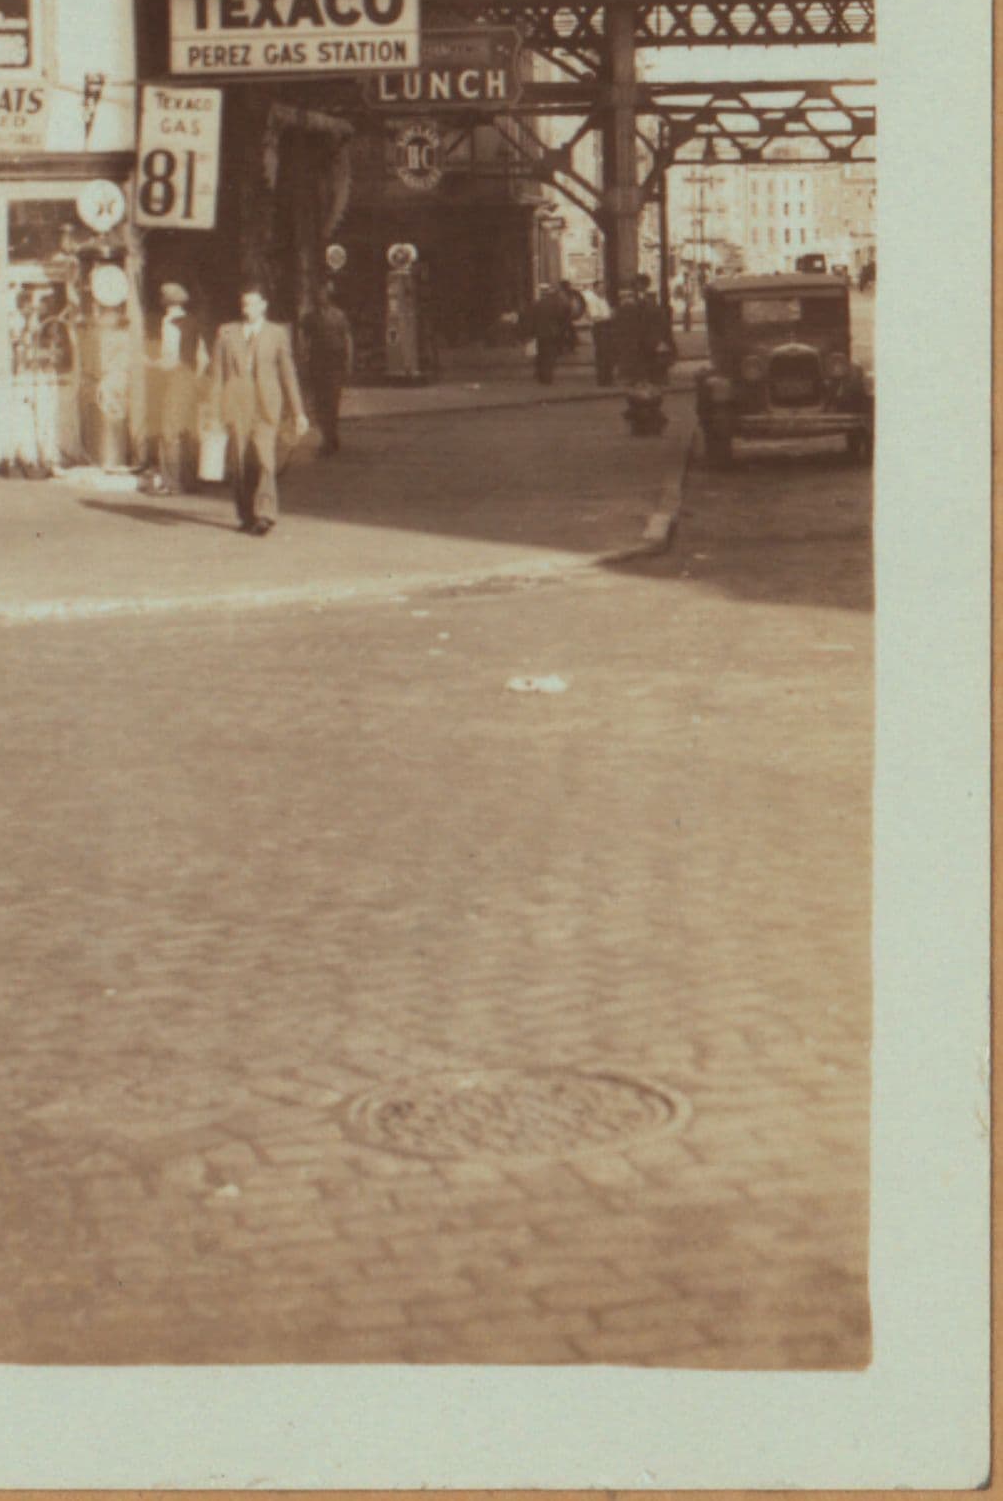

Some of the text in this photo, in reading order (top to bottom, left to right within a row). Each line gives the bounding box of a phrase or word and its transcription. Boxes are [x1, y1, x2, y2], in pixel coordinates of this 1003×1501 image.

[188, 45, 251, 67] PEREZ
[264, 43, 307, 65] GAS
[318, 40, 407, 63] STATION
[379, 69, 506, 101] LUNCH
[160, 117, 201, 136] GAS
[139, 147, 197, 220] 81
